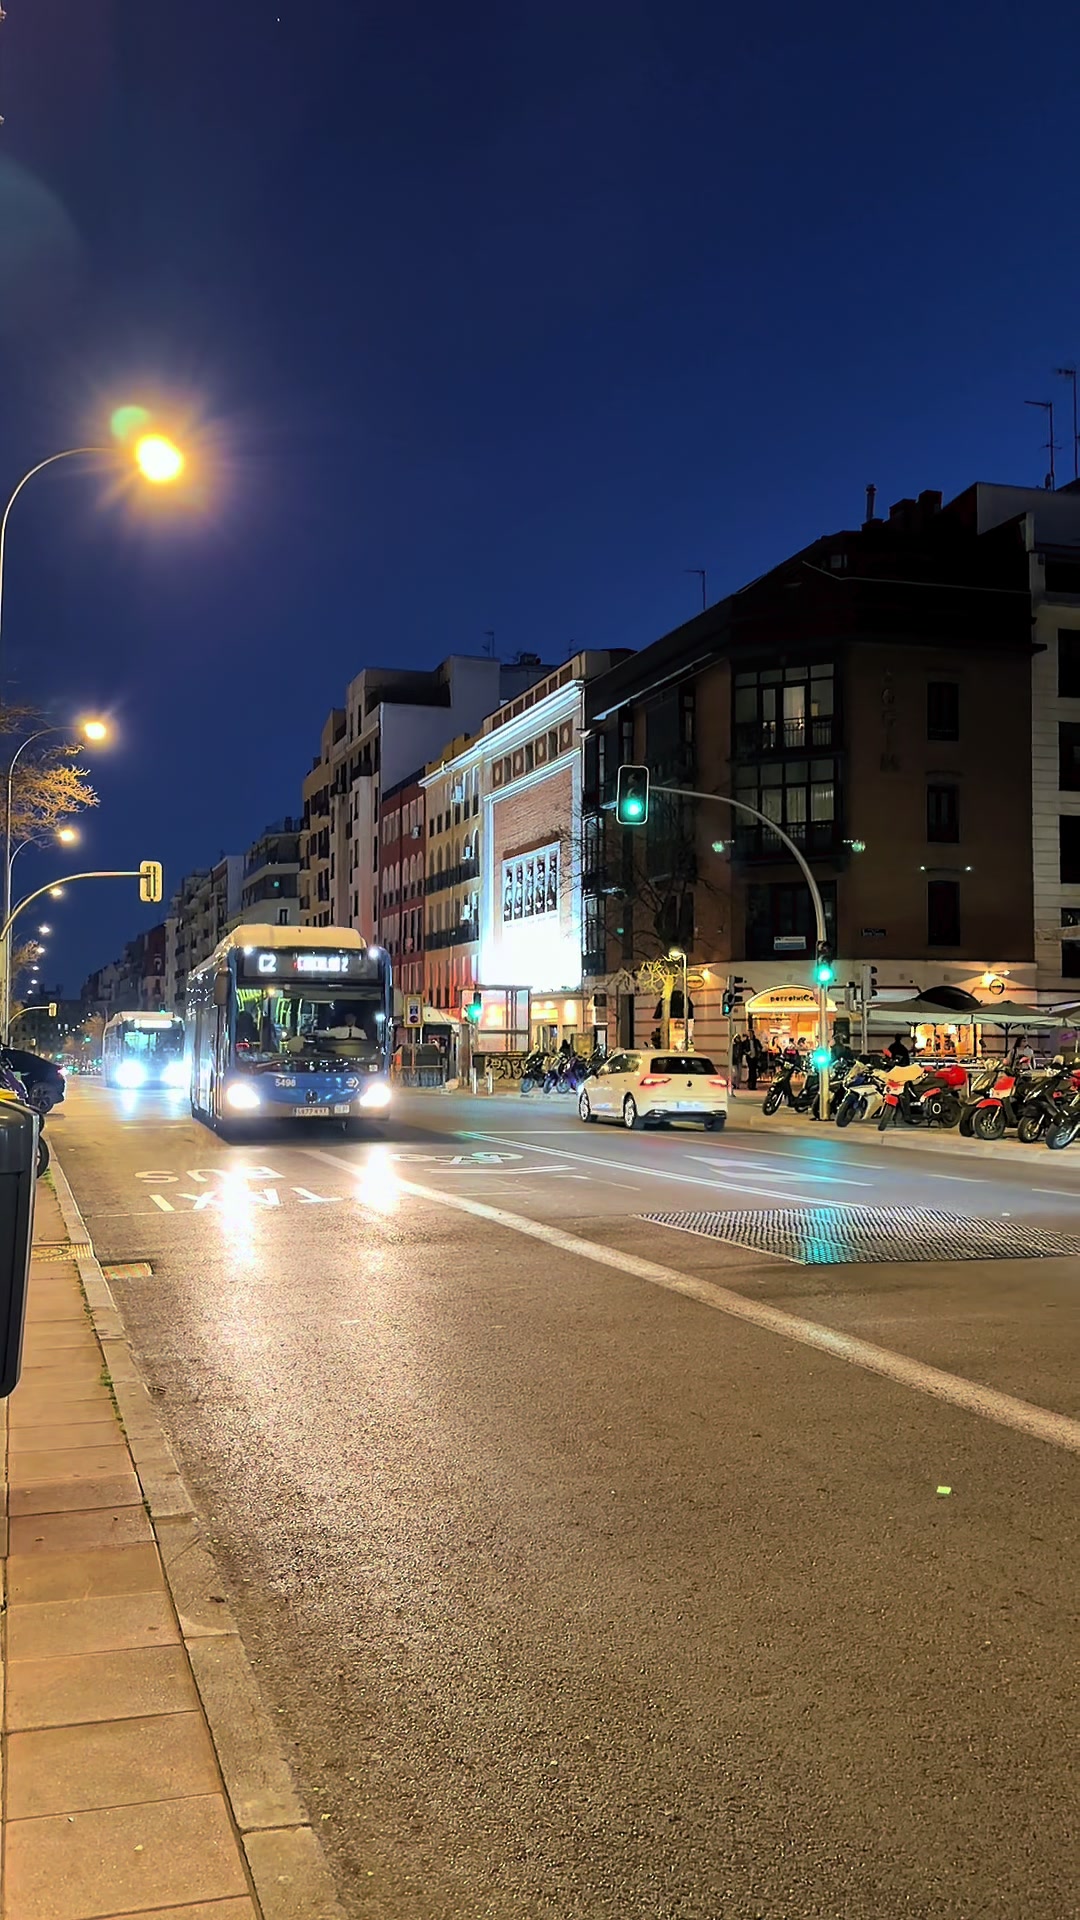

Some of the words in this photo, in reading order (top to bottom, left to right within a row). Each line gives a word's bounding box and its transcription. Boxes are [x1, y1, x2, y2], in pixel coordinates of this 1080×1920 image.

[259, 953, 276, 972] C2
[134, 1166, 284, 1183] BUS
[149, 1187, 343, 1212] TAXI
